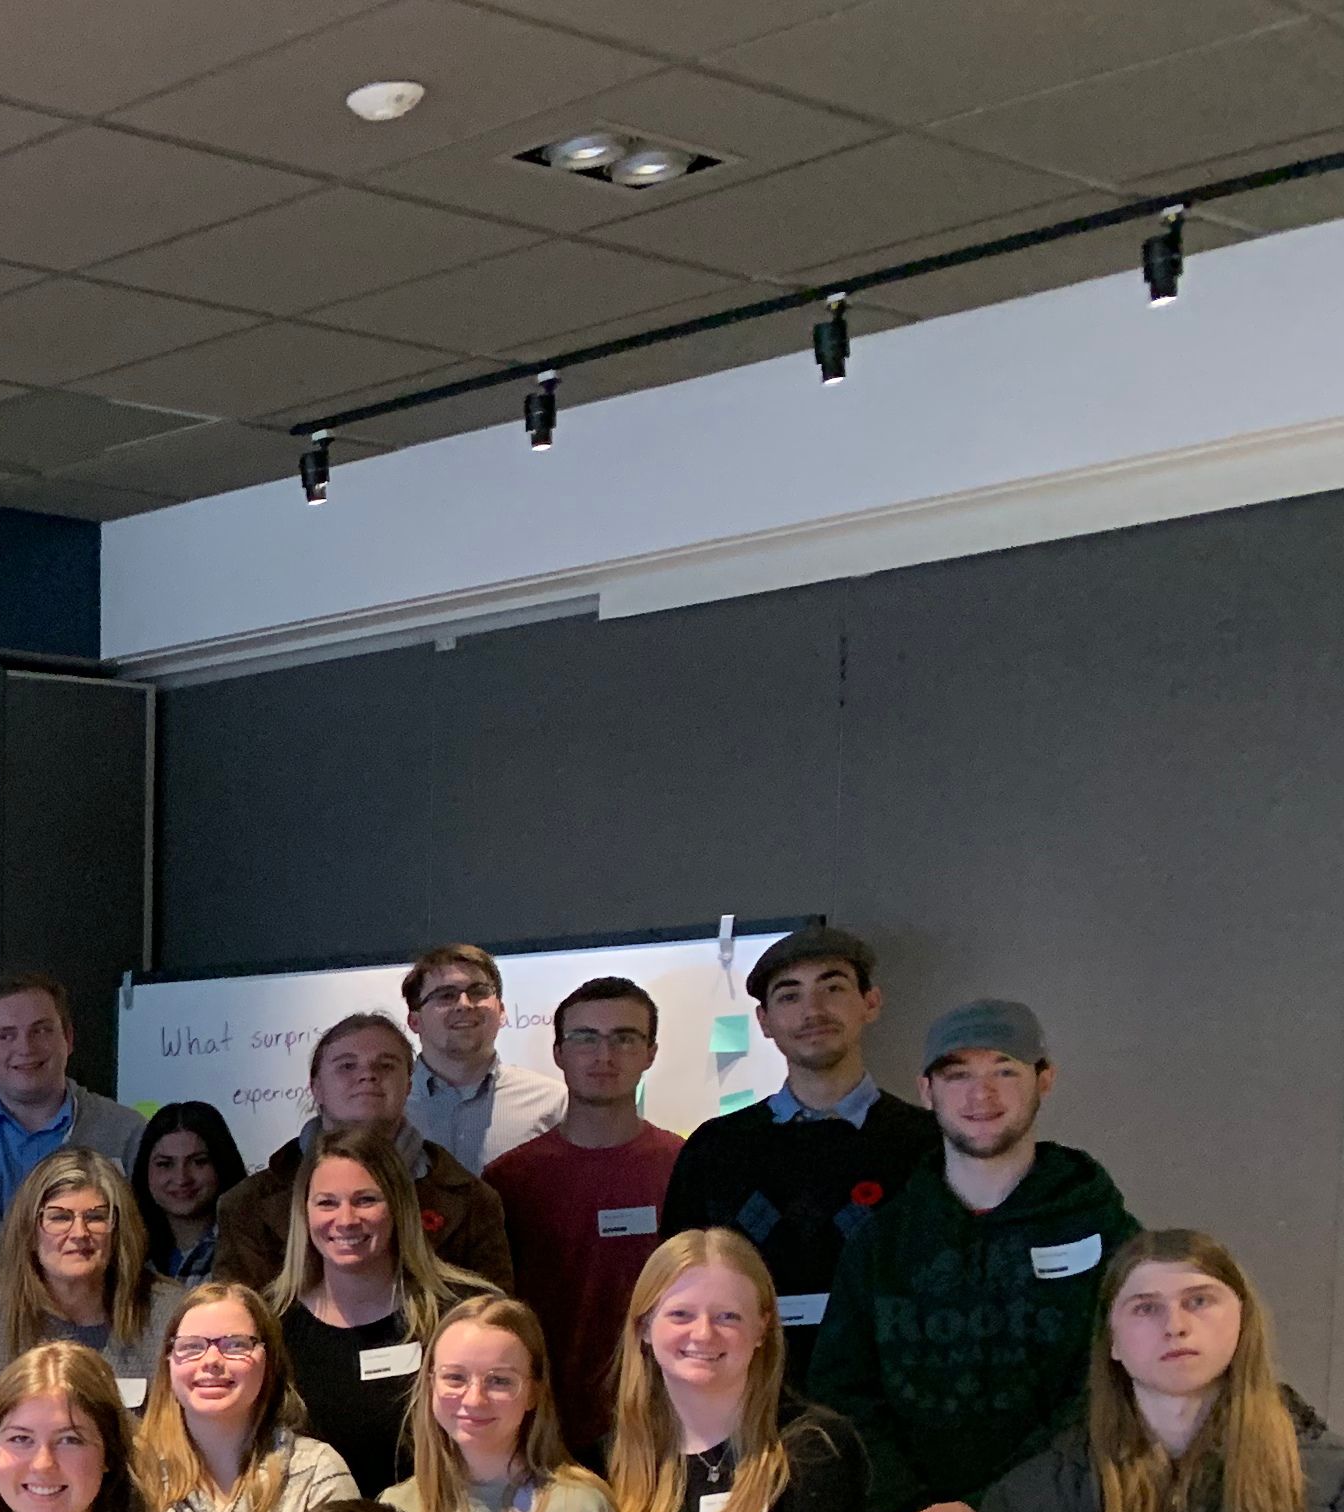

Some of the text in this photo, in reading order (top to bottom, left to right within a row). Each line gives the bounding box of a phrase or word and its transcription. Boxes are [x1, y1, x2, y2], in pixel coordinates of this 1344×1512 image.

[161, 1021, 233, 1057] What
[499, 1003, 555, 1030] abou
[232, 1086, 305, 1115] experien
